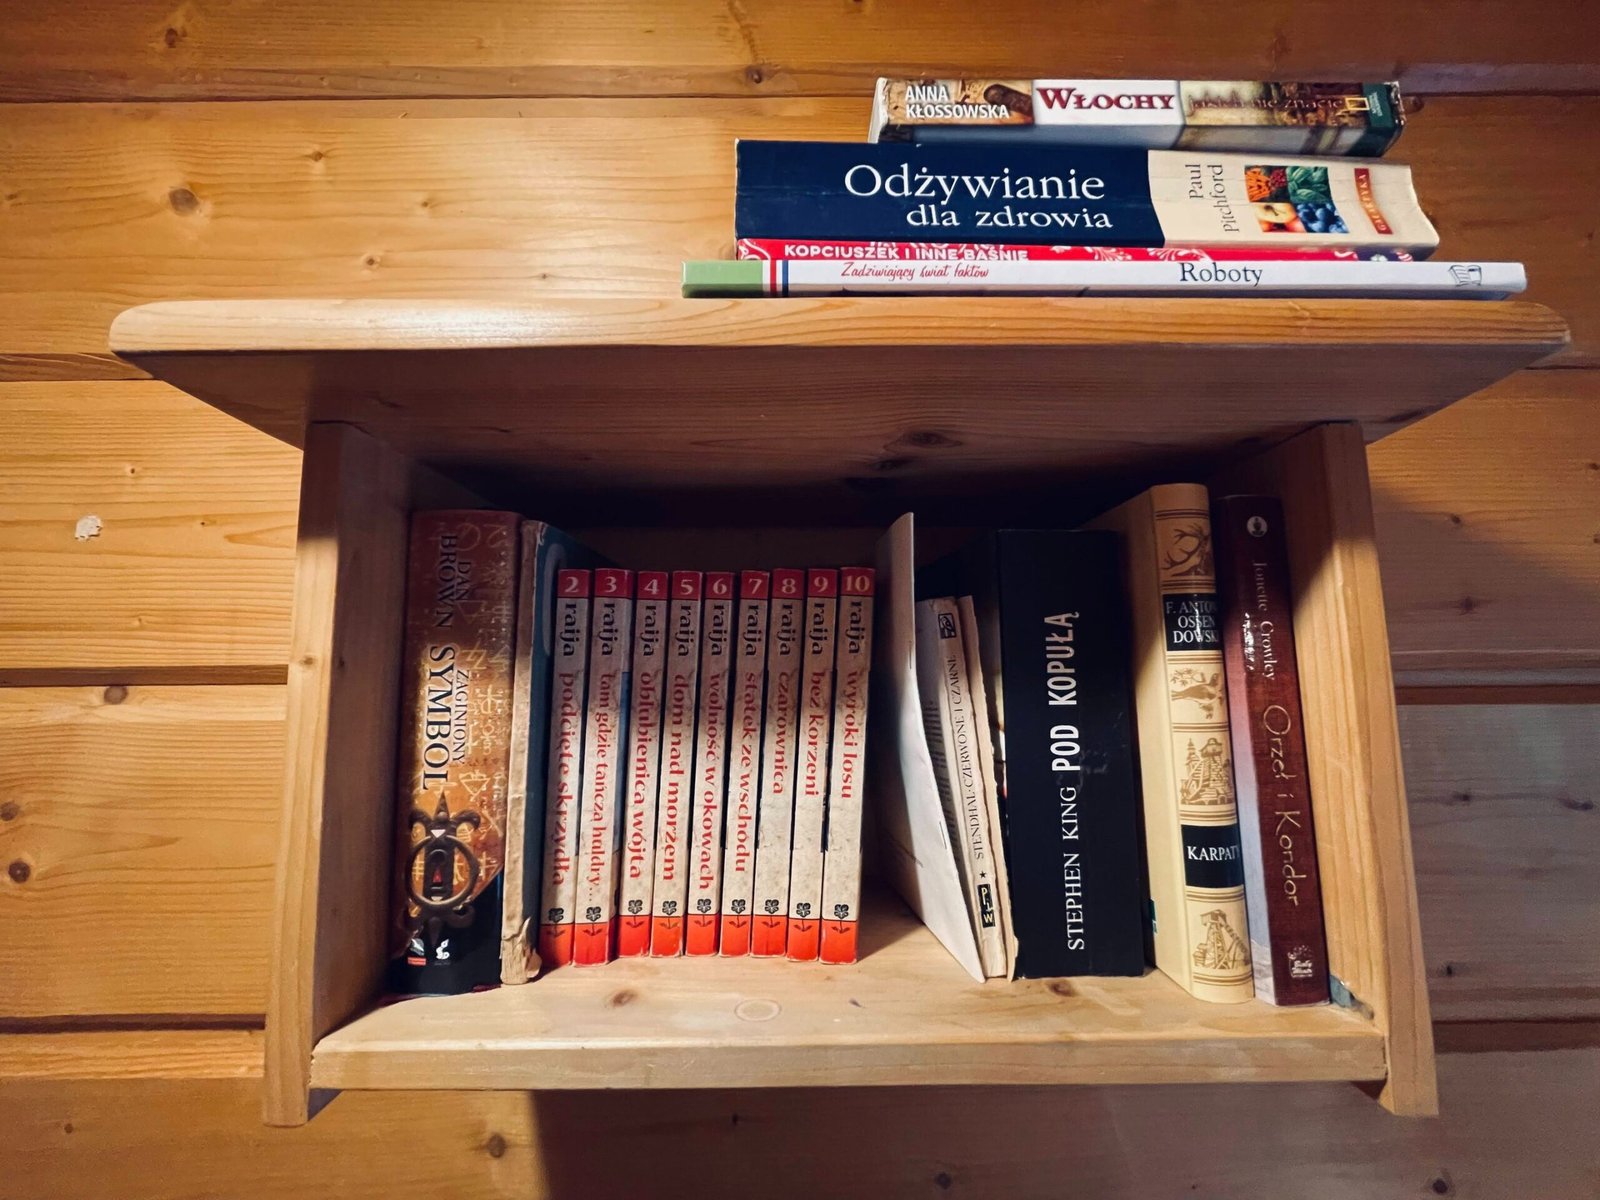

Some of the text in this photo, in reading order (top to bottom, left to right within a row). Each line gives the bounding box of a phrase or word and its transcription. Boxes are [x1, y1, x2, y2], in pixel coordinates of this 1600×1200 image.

[905, 85, 949, 101] ANNA
[905, 103, 1010, 119] KŁOSSOWSKA
[1036, 87, 1176, 111] WŁOCHY
[843, 163, 1106, 204] Odżywianie
[1184, 163, 1204, 200] Paul
[1206, 163, 1240, 233] Pitchford
[906, 204, 1114, 230] dla zdrowia
[784, 243, 899, 261] KOPCIUSZEK
[915, 246, 961, 261] INNE
[841, 261, 990, 282] Zadziwiający świat faktów
[1179, 261, 1264, 287] Roboty
[434, 535, 458, 628] BROWN
[457, 560, 472, 600] DAN
[563, 576, 579, 594] 2
[604, 576, 617, 593] 3
[644, 578, 658, 595] 4
[680, 579, 694, 595] 5
[712, 578, 727, 595] 6
[748, 578, 762, 595] 7
[781, 578, 796, 595] 8
[813, 576, 828, 593] 9
[844, 575, 870, 593] 10
[559, 602, 580, 657] raija
[597, 602, 619, 656] raija
[639, 604, 659, 657] raija
[674, 604, 695, 657] raija
[708, 603, 728, 656] raija
[742, 603, 762, 656] raija
[776, 603, 796, 656] raija
[808, 602, 828, 655] raija
[845, 601, 865, 654] raija
[1260, 620, 1278, 681] Crowley
[599, 672, 615, 708] tam
[946, 653, 962, 705] CZARNE
[1044, 611, 1081, 772] POD KOPUŁĄ
[422, 645, 456, 791] SYMBOL
[451, 669, 470, 765] ZAGINIONY
[742, 672, 758, 740] statek
[595, 712, 612, 758] gdzie
[740, 744, 753, 767] ze
[772, 671, 790, 795] czarownica
[804, 671, 826, 796] bez korzeni
[841, 670, 859, 799] wyroki losu
[956, 713, 975, 787] CZERWONE
[1262, 704, 1298, 781] Orzeł
[627, 672, 656, 879] oblubienica wójta
[662, 674, 689, 881] dom nad morzem
[699, 672, 724, 890] wolność w okowach
[552, 781, 574, 886] skrzydła
[966, 793, 985, 860] STENDHAL
[1059, 785, 1085, 951] STEPHEN KING
[1275, 810, 1308, 907] Kondor
